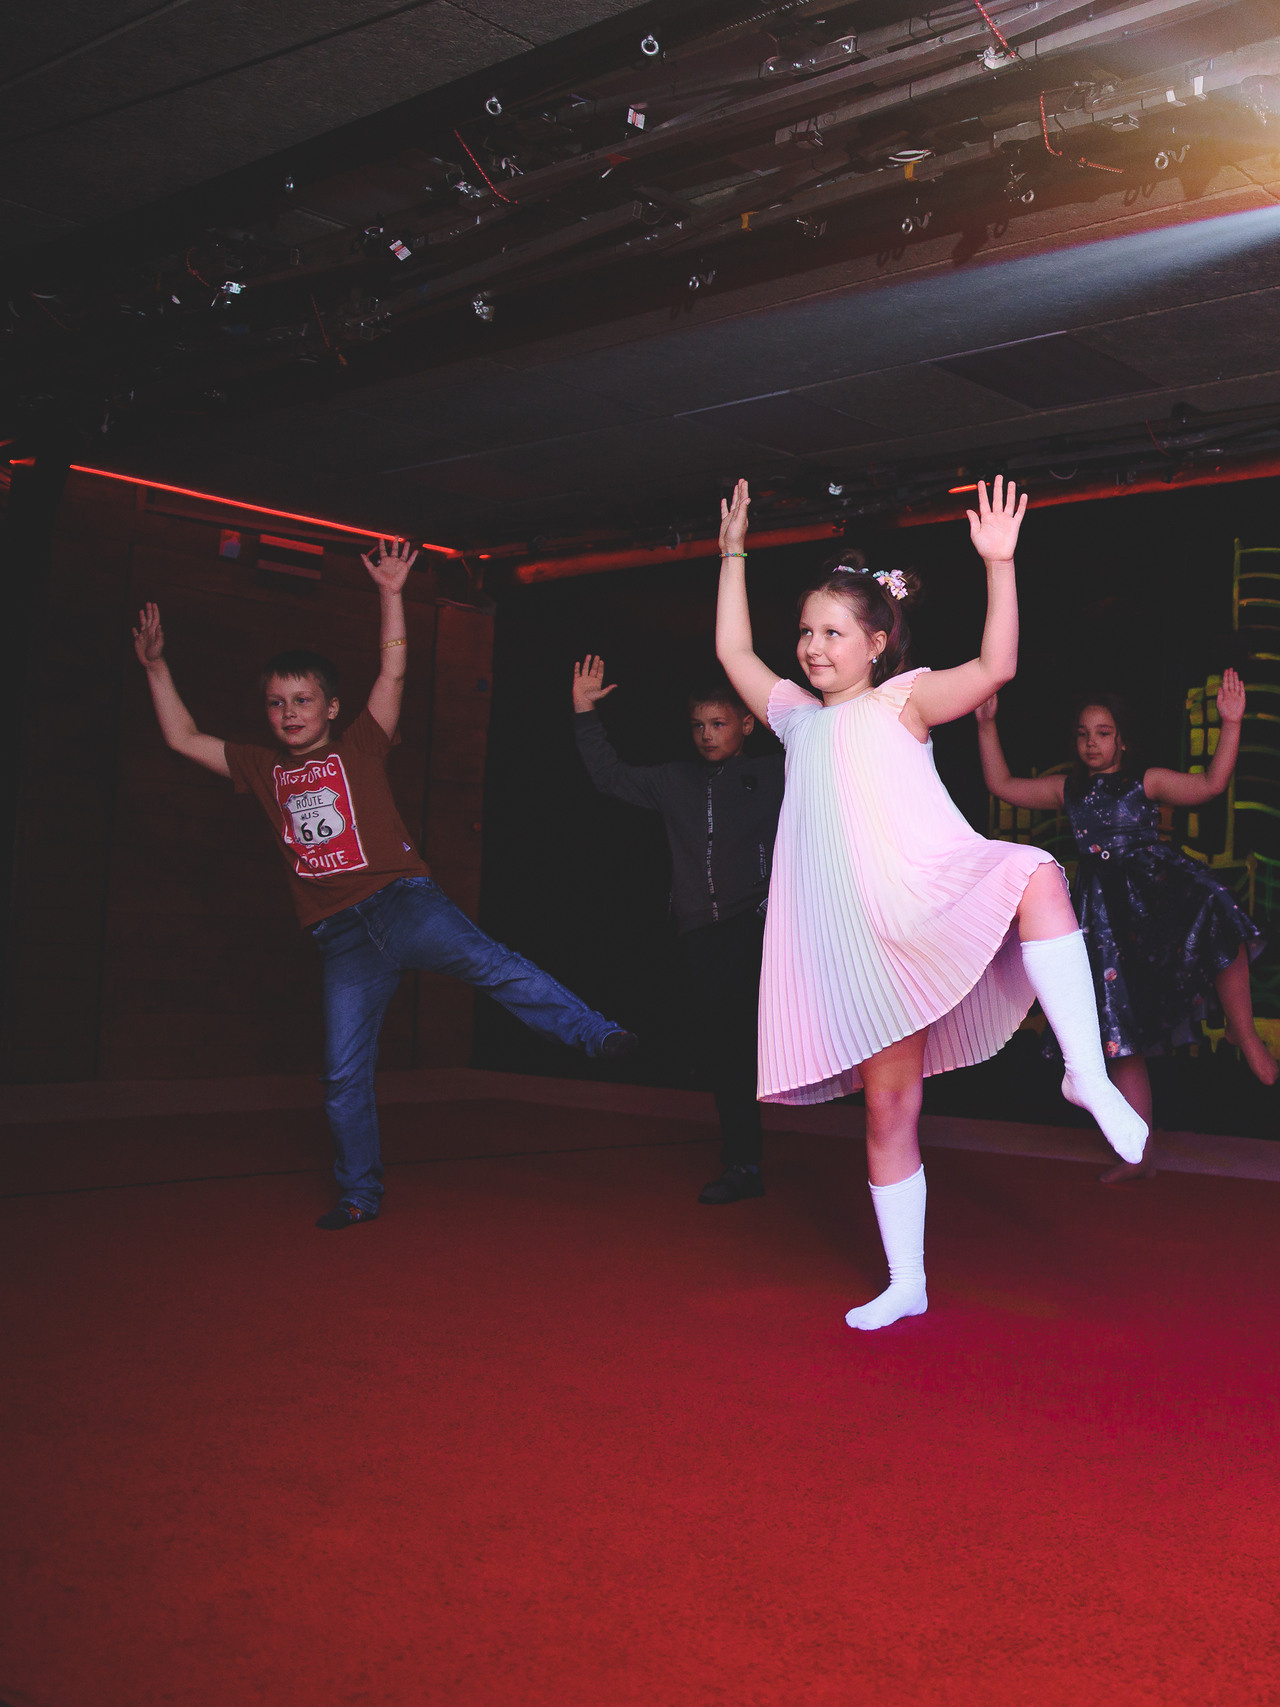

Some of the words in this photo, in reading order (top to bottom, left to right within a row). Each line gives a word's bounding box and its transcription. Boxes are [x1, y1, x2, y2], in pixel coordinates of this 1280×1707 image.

[279, 762, 337, 786] HISTORIC
[296, 795, 324, 810] ROUTE
[300, 818, 333, 842] 66
